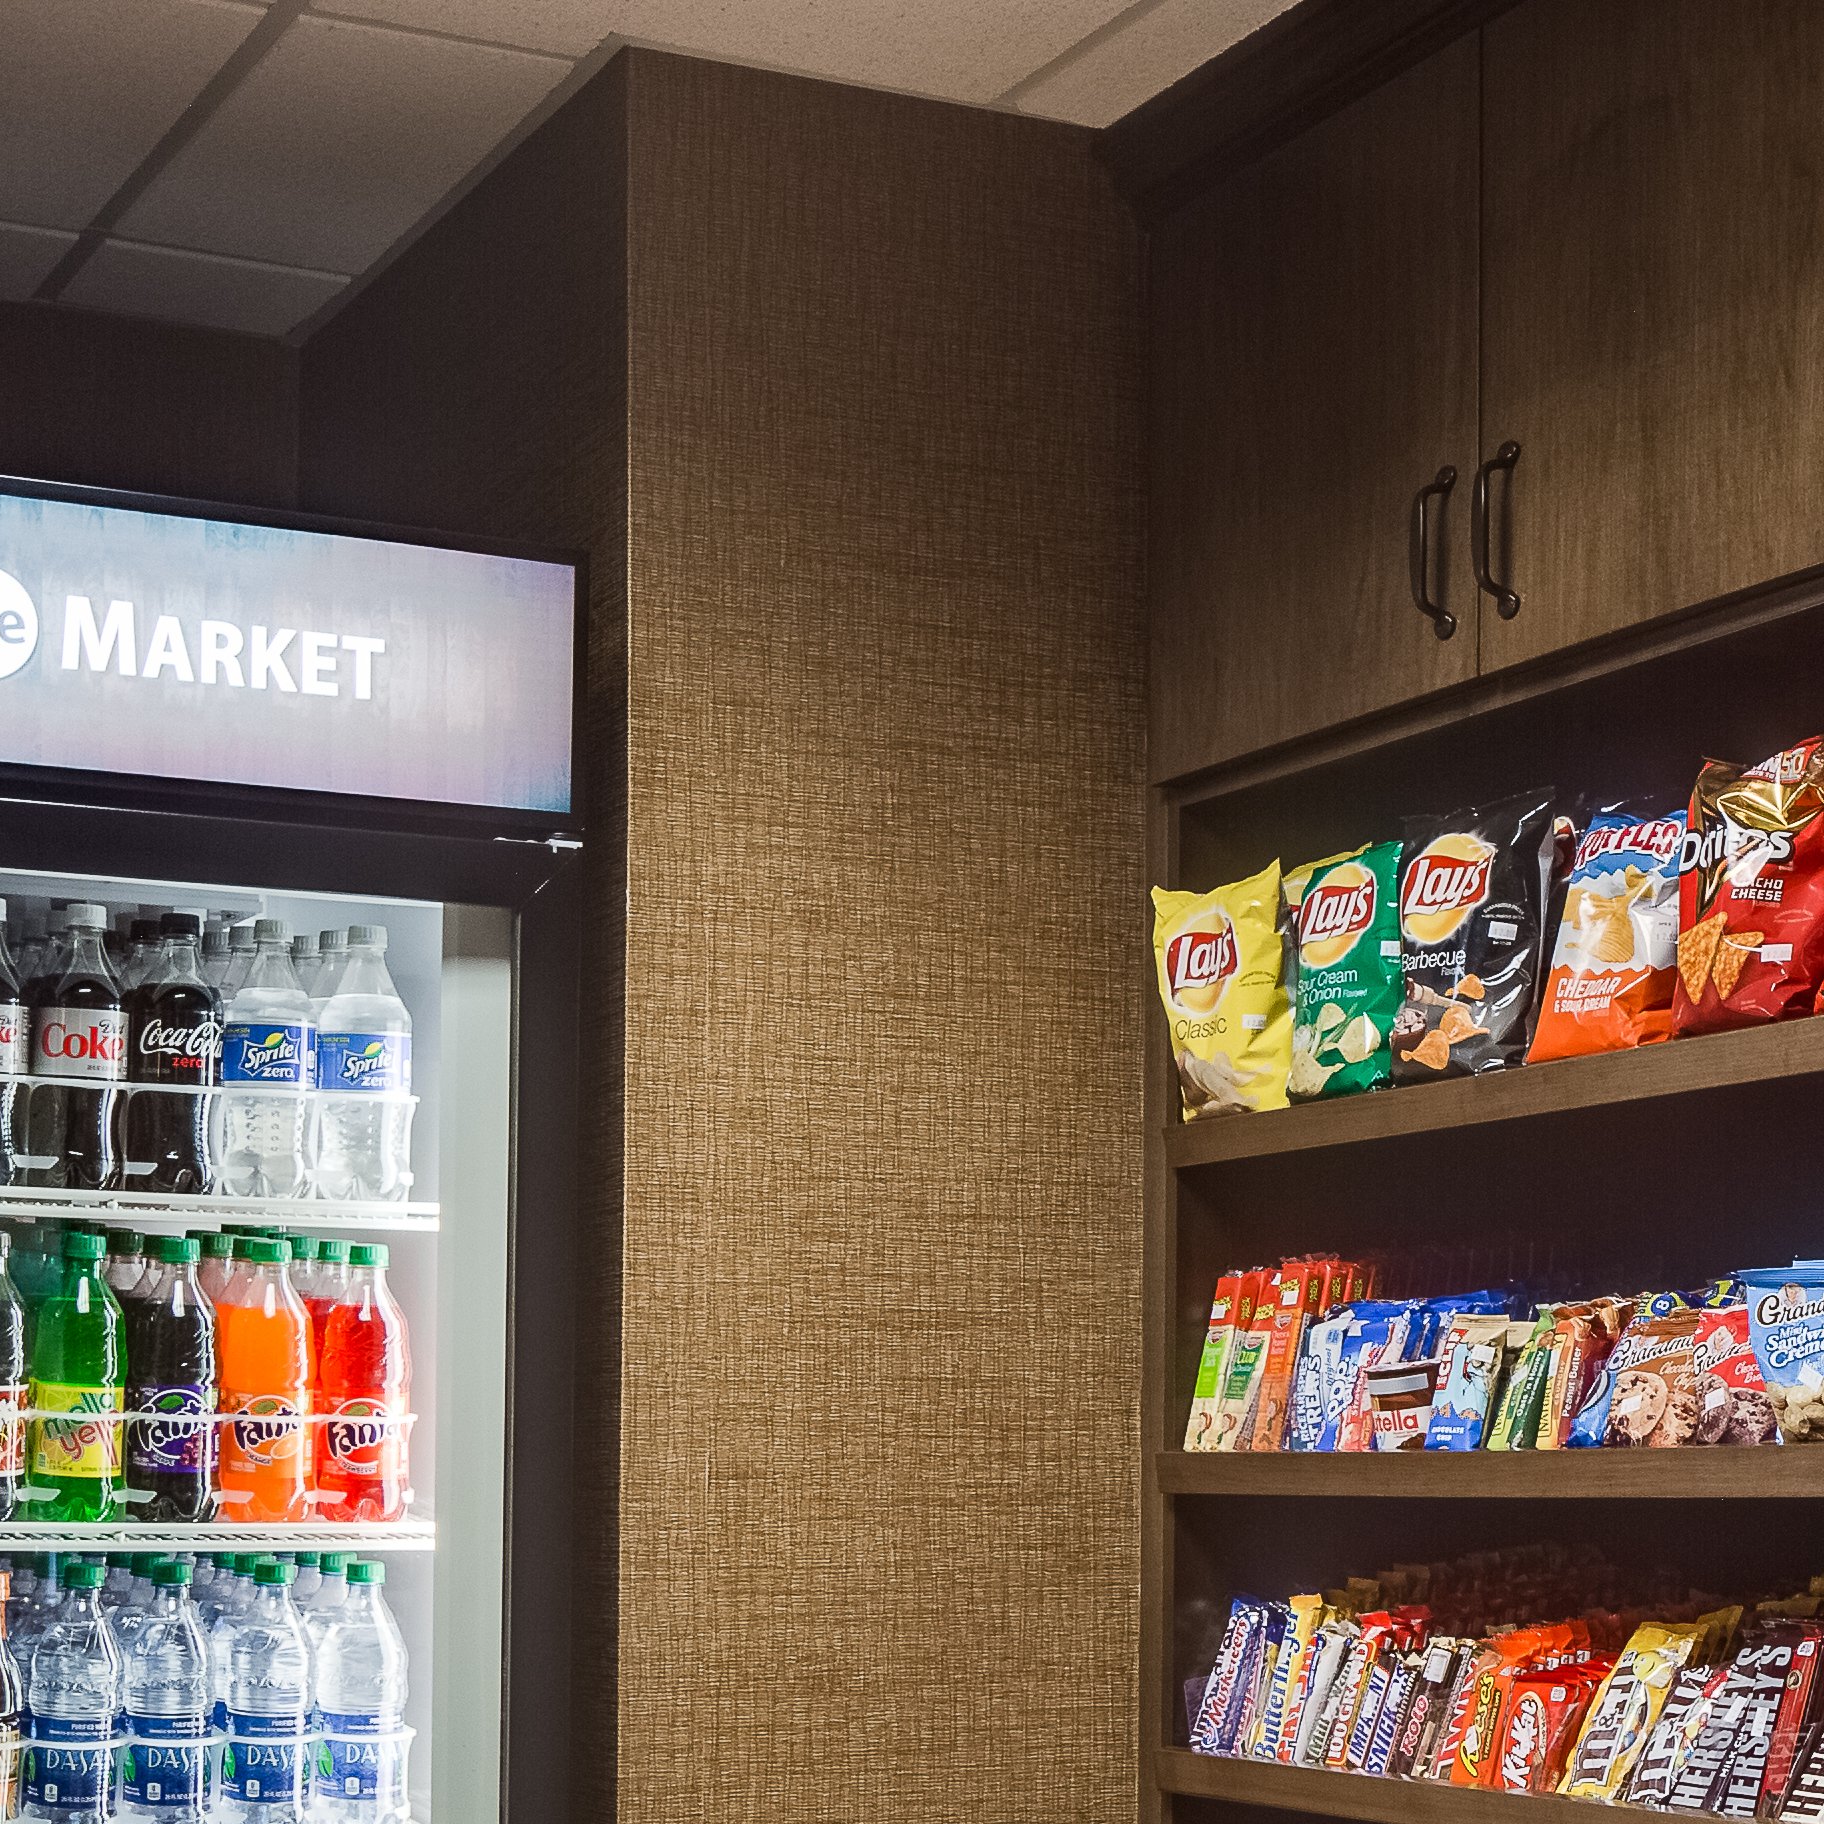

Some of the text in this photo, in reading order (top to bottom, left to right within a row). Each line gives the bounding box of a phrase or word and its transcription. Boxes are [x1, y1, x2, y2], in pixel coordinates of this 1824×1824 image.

[62, 596, 385, 700] MARKET
[1576, 820, 1682, 870] RUFFLES
[1680, 827, 1794, 873] Doritos
[1404, 856, 1490, 916] Lay's
[1731, 888, 1782, 901] CHEESE
[1301, 883, 1374, 944] Lay's
[1173, 927, 1233, 989] Lay's
[1403, 949, 1466, 972] Barbecue
[1318, 969, 1357, 986] Cream
[1556, 976, 1621, 997] CHEDDAR
[1309, 986, 1341, 1005] Onion
[42, 1023, 124, 1061] Coke
[1175, 1015, 1227, 1041] Classic
[172, 1056, 205, 1069] zero
[244, 1039, 293, 1069] Sprite
[261, 1065, 294, 1079] zero
[1779, 1325, 1803, 1340] Mini
[1254, 1613, 1298, 1760] Butterfinger
